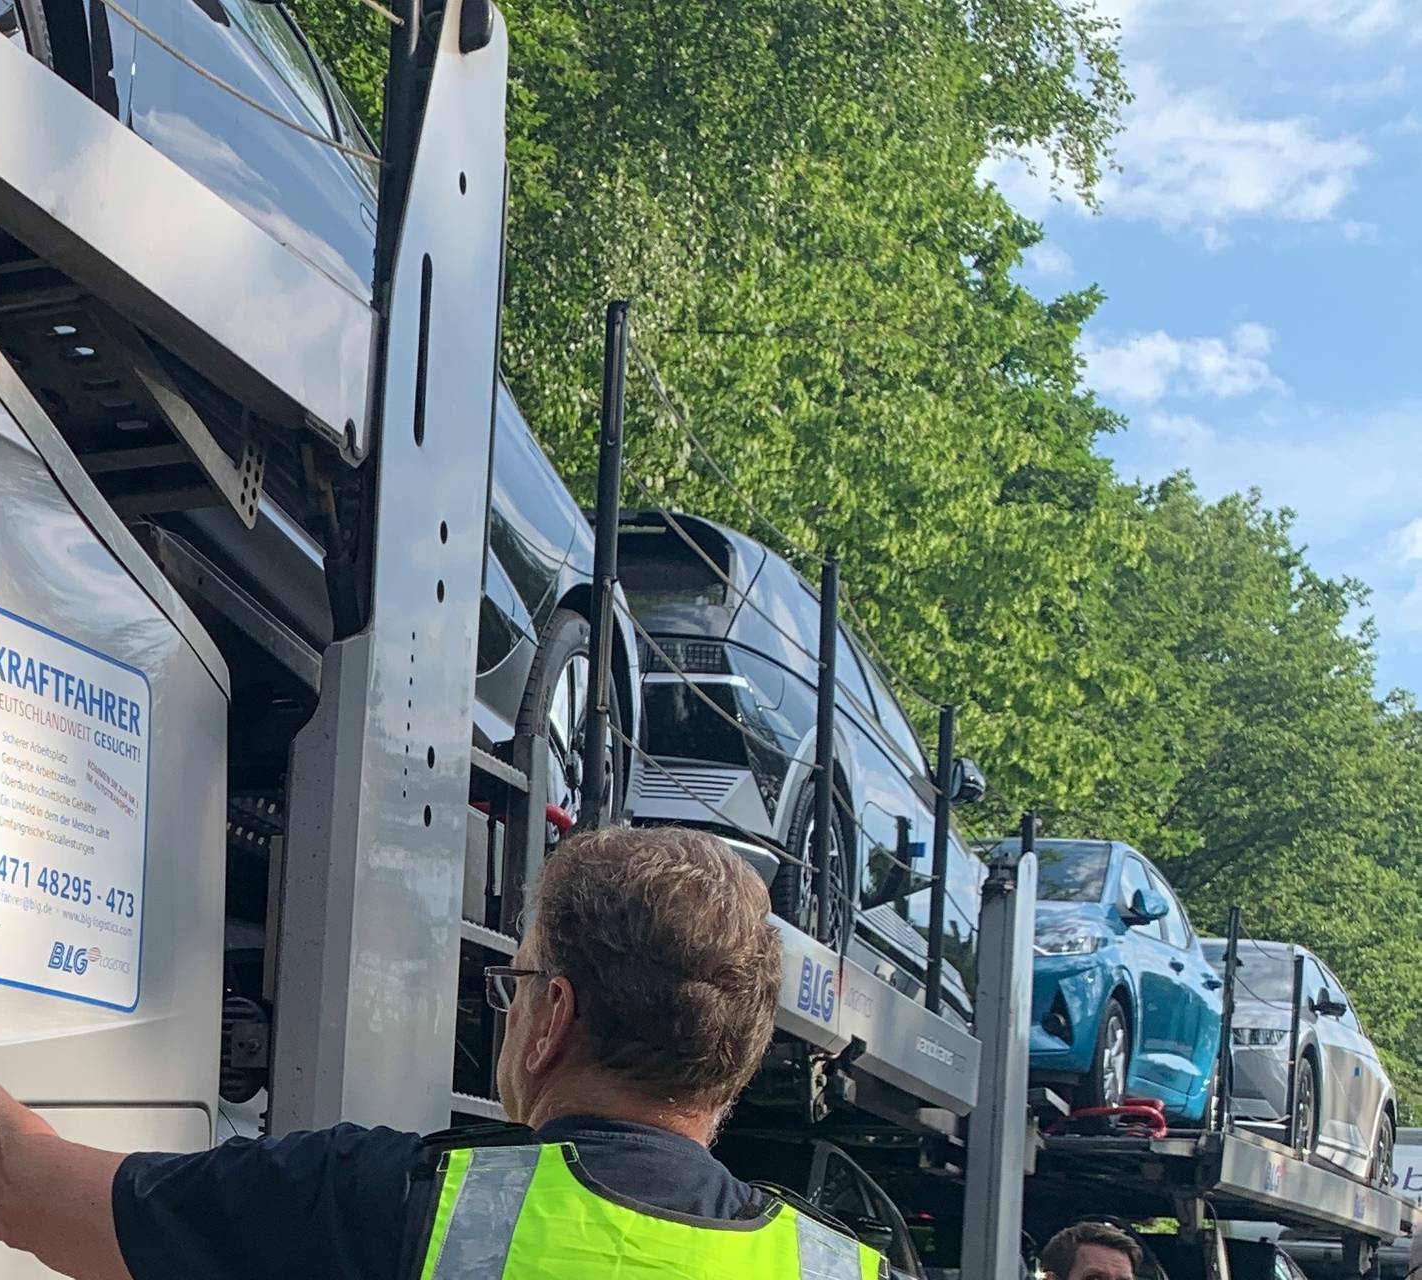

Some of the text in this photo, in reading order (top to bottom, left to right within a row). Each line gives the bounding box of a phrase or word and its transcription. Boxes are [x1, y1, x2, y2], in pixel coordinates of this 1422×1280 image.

[30, 741, 67, 763] Arbeitsplatz
[94, 731, 140, 762] GESUCHT!
[35, 765, 76, 786] Arbeitszeiten
[44, 808, 59, 822] dem
[37, 867, 92, 905] 48295
[106, 887, 134, 918] 473
[48, 941, 88, 975] BLG
[797, 955, 836, 1023] BLG
